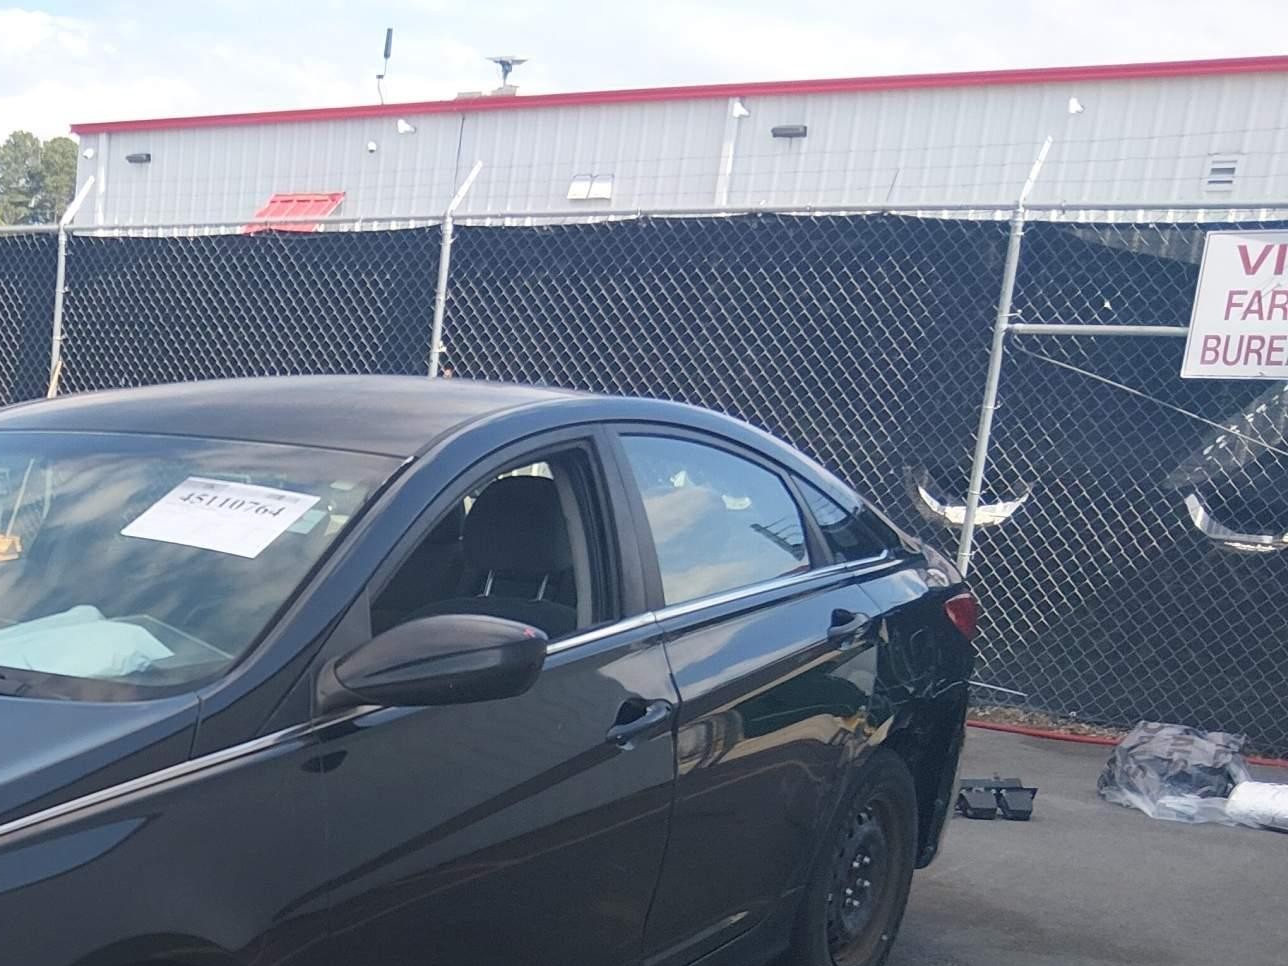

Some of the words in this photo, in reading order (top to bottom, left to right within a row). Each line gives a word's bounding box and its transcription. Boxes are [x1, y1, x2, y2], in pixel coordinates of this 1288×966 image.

[1237, 243, 1288, 276] VI
[1224, 289, 1288, 321] FAR
[1199, 334, 1288, 366] BURE
[178, 492, 287, 517] 45110764
